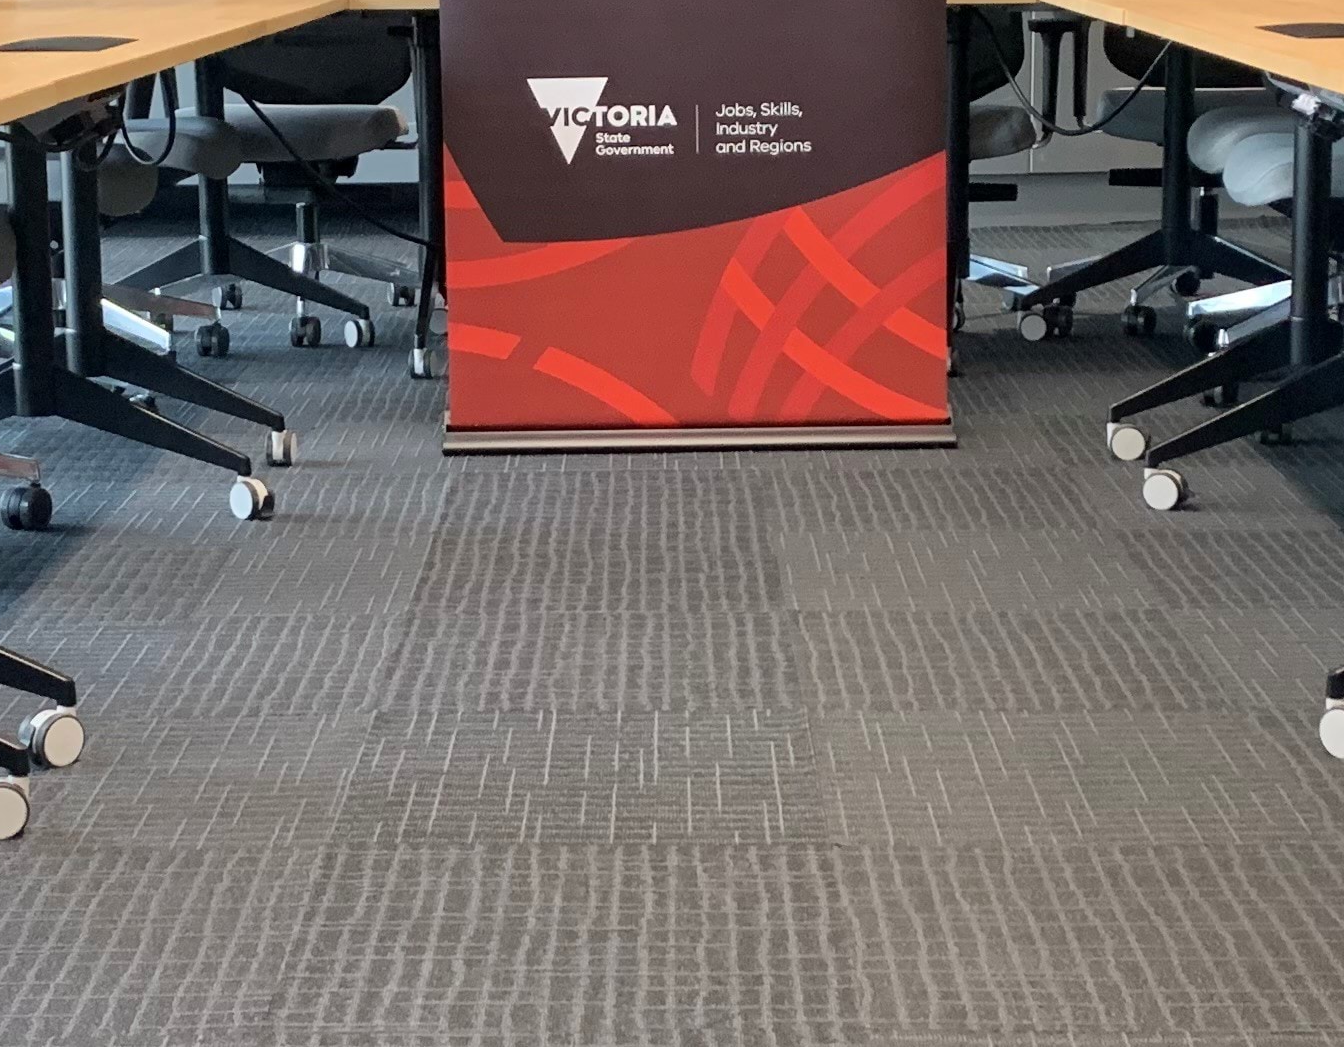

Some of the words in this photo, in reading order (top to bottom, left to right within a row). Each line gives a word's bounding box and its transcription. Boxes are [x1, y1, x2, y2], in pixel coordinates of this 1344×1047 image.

[541, 104, 678, 127] VICTORIA
[716, 103, 756, 118] Jobs,
[761, 102, 802, 117] Skills,
[717, 122, 778, 137] Industry
[595, 132, 632, 144] State
[595, 144, 676, 156] Government
[716, 140, 745, 153] and
[750, 139, 811, 155] Regions
